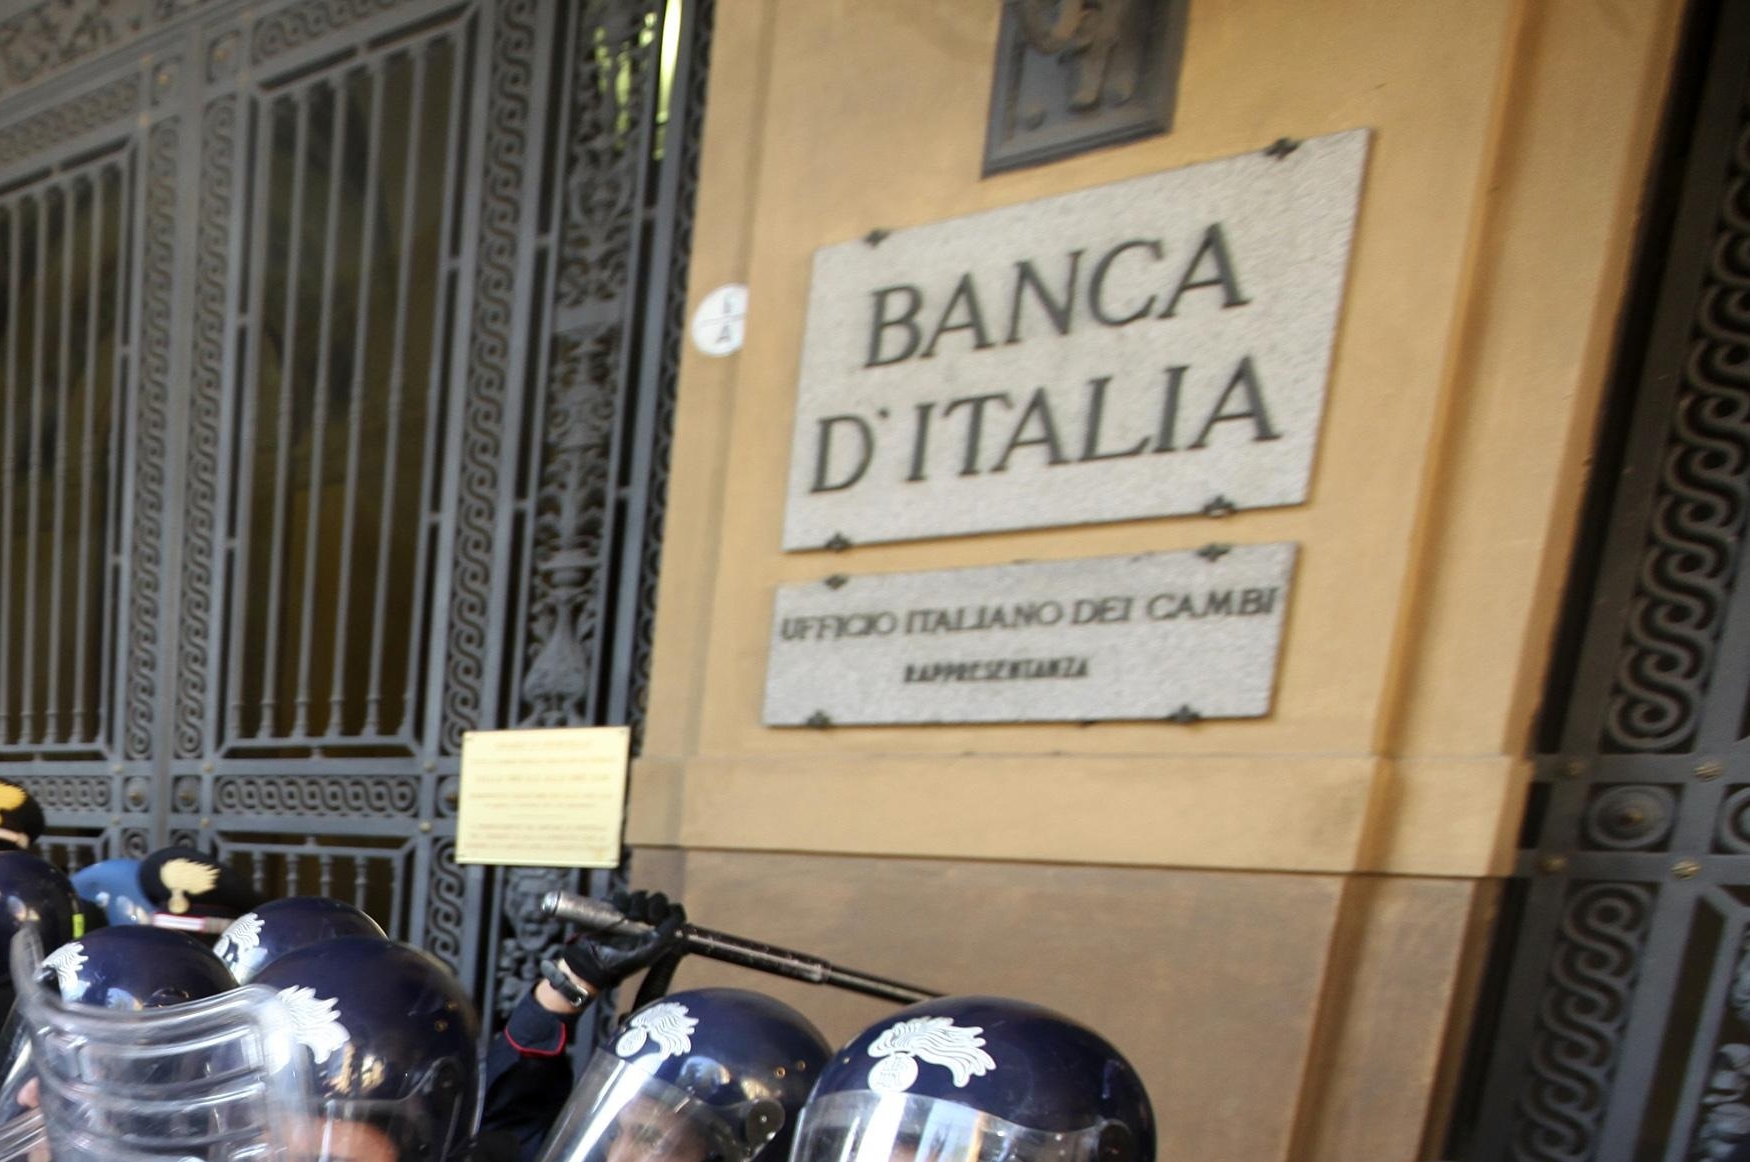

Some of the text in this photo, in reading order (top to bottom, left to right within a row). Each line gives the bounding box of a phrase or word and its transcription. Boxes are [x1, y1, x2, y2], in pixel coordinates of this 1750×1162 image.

[864, 221, 1253, 370] BANCA
[808, 355, 1284, 494] D'ITALIA
[780, 585, 1280, 641] UFFICIO ITALIANO DEI CAMBI
[903, 656, 1090, 684] RAPPRESENTANZA
